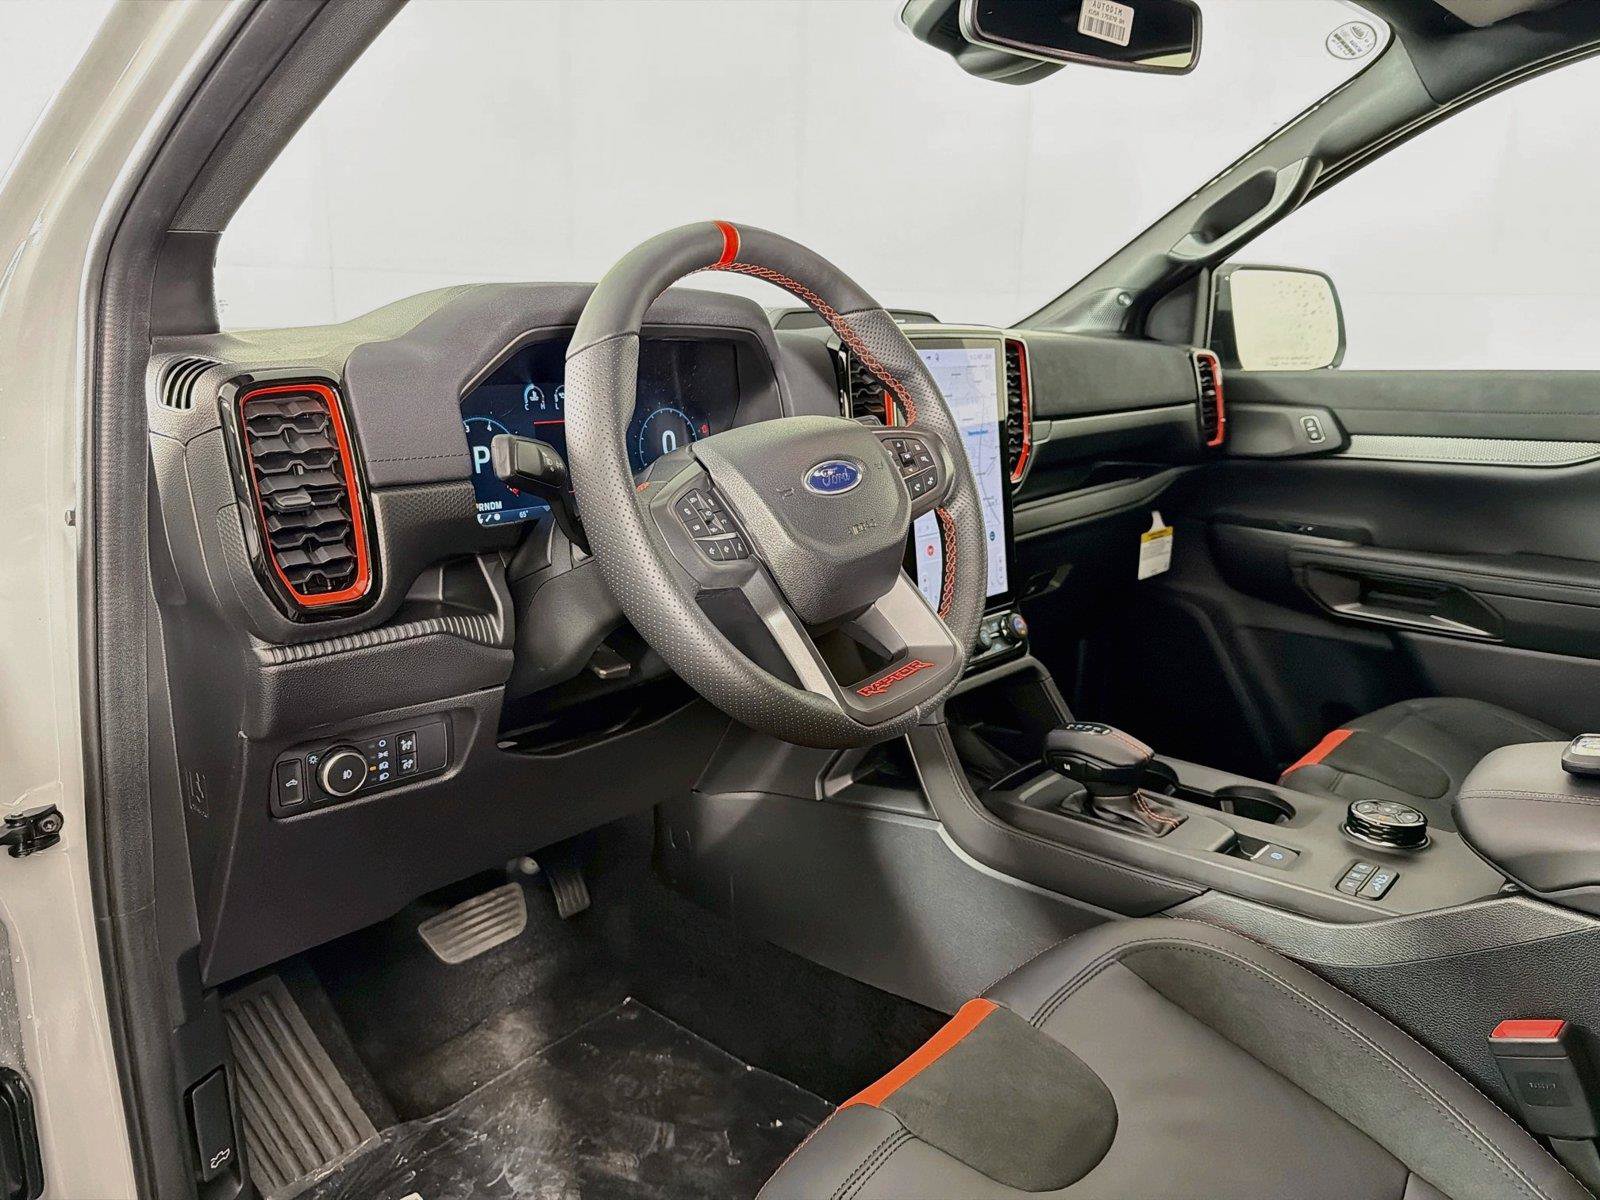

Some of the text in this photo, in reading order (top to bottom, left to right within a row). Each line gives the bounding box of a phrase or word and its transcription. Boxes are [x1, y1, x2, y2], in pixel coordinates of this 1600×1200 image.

[486, 423, 492, 432] 4
[473, 445, 490, 474] P
[821, 466, 851, 487] Ford
[856, 659, 935, 697] RAPTOR
